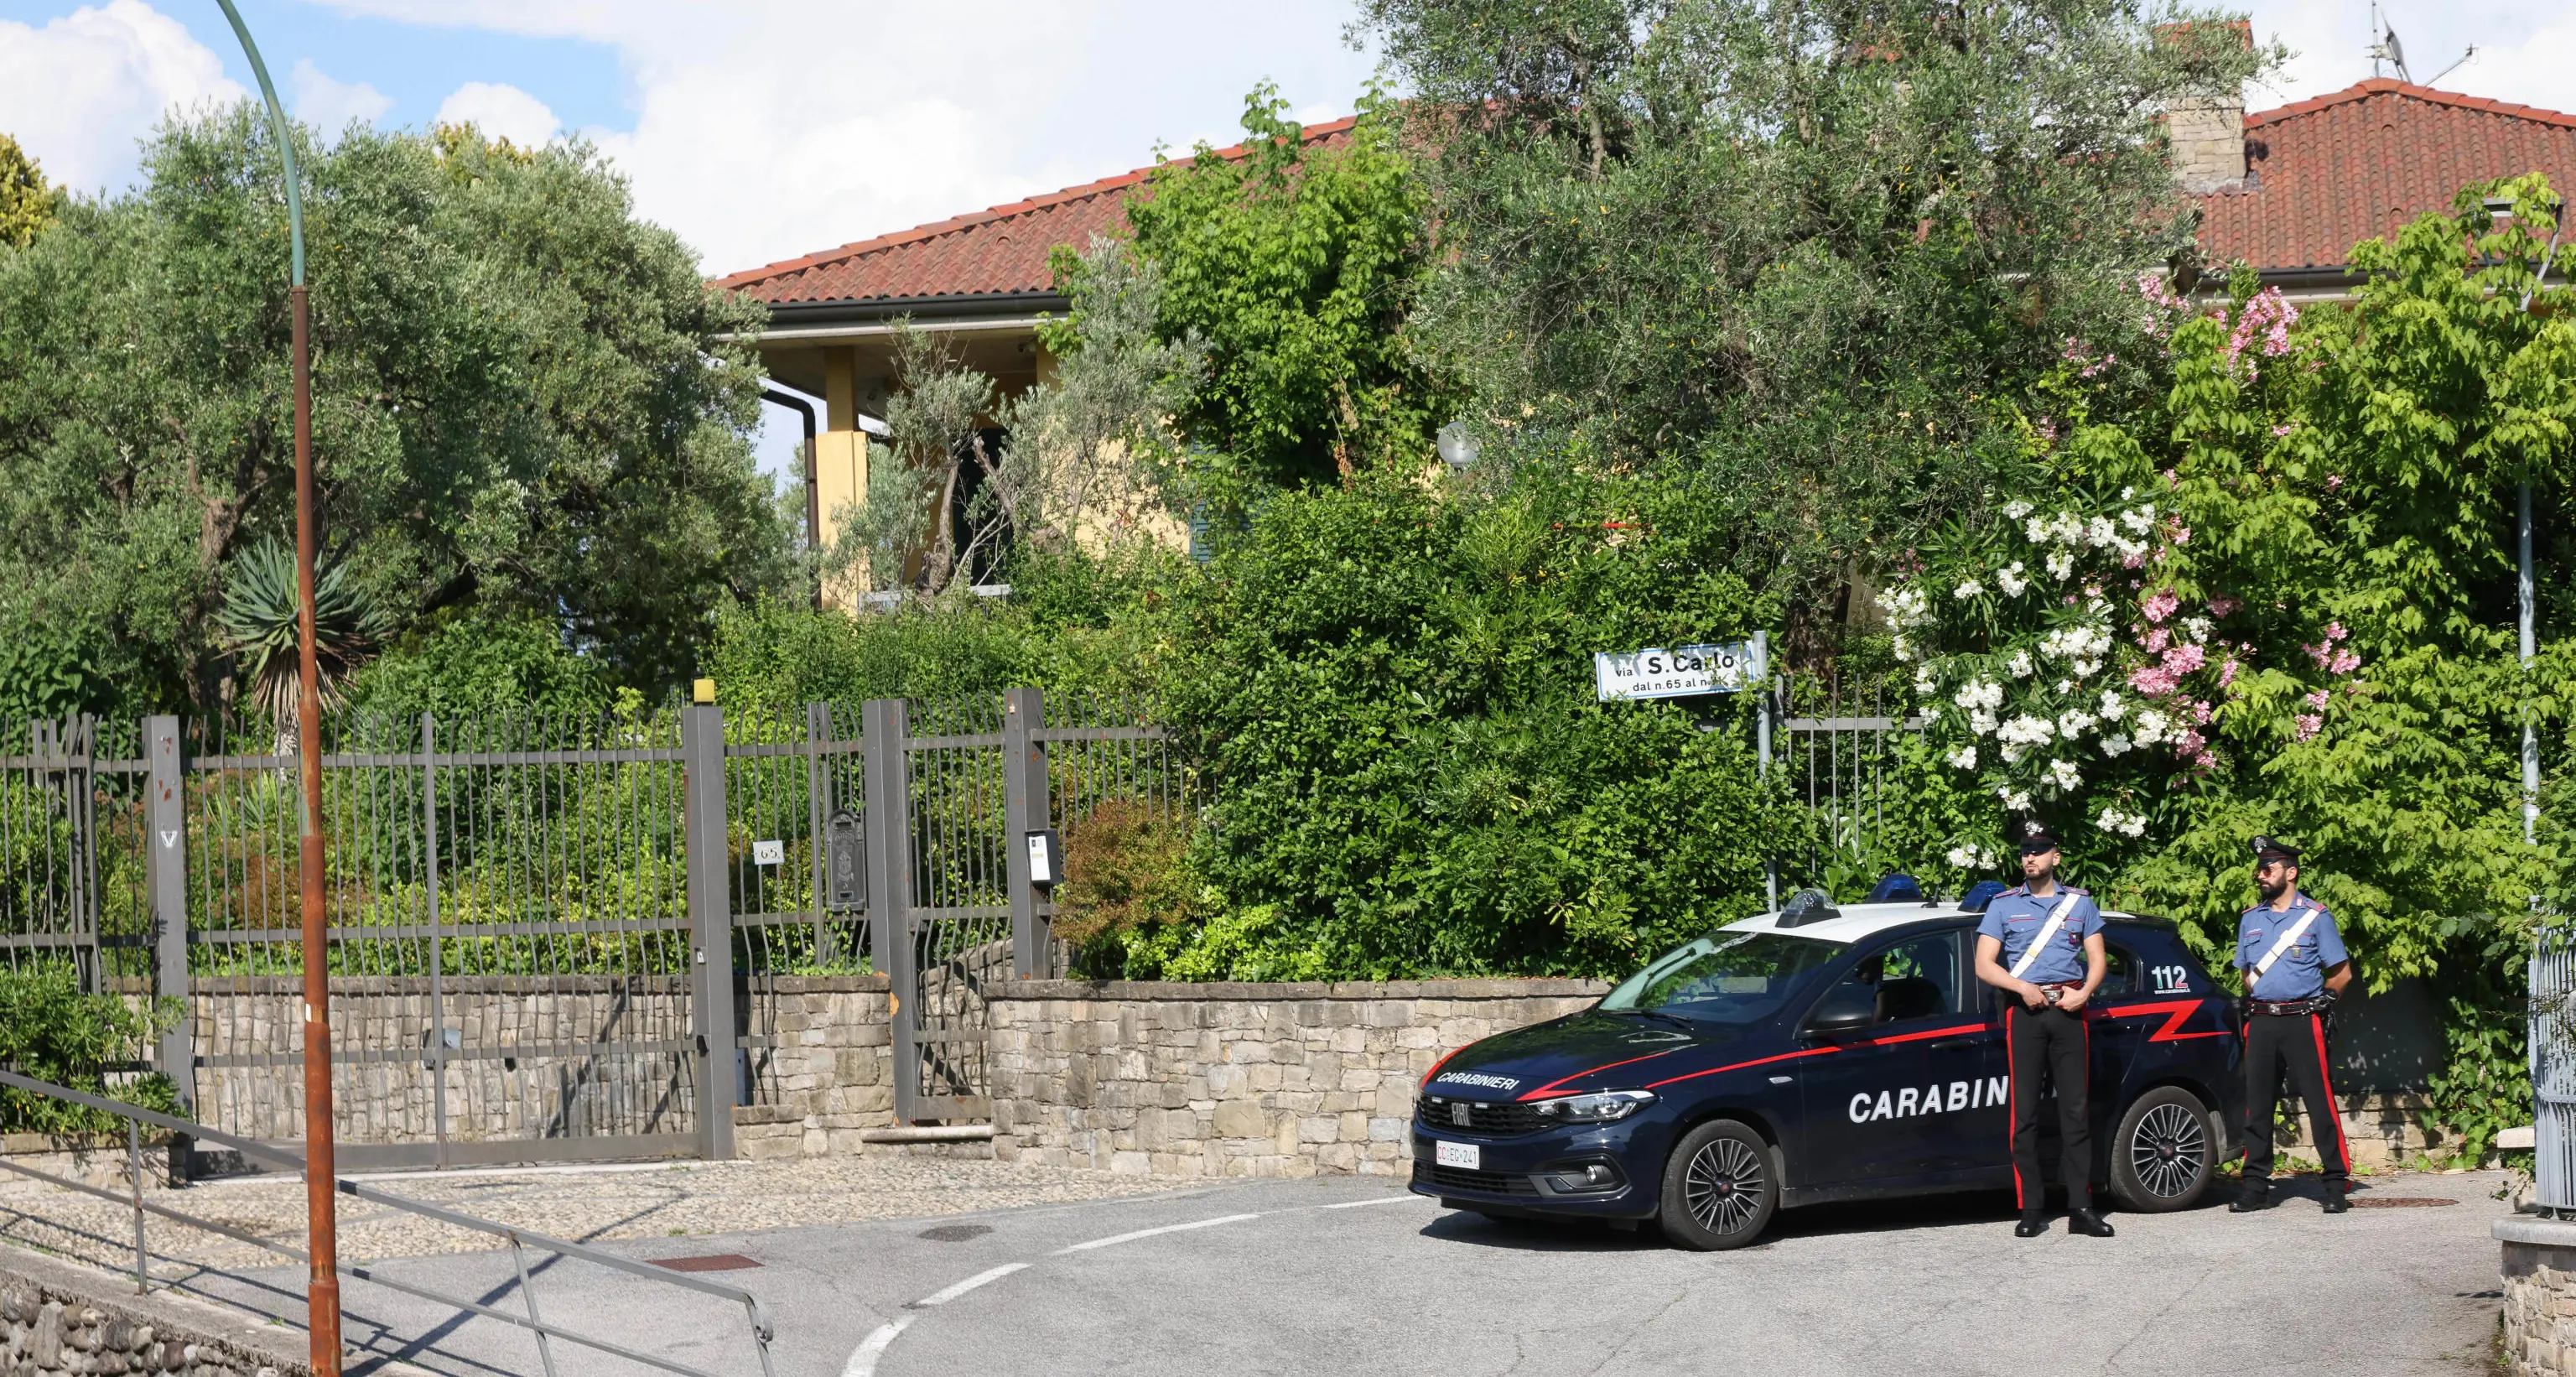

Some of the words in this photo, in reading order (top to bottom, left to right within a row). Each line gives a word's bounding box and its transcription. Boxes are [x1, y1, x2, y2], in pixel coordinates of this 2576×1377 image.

[1615, 668, 1633, 677] via
[1633, 682, 1650, 692] dal
[1655, 679, 1681, 690] n.65
[1685, 678, 1696, 688] al
[2151, 966, 2188, 989] 112
[1436, 1073, 1520, 1090] CARABINIERI
[1849, 1071, 2058, 1124] CARABIN
[1452, 1102, 1471, 1126] FIAT
